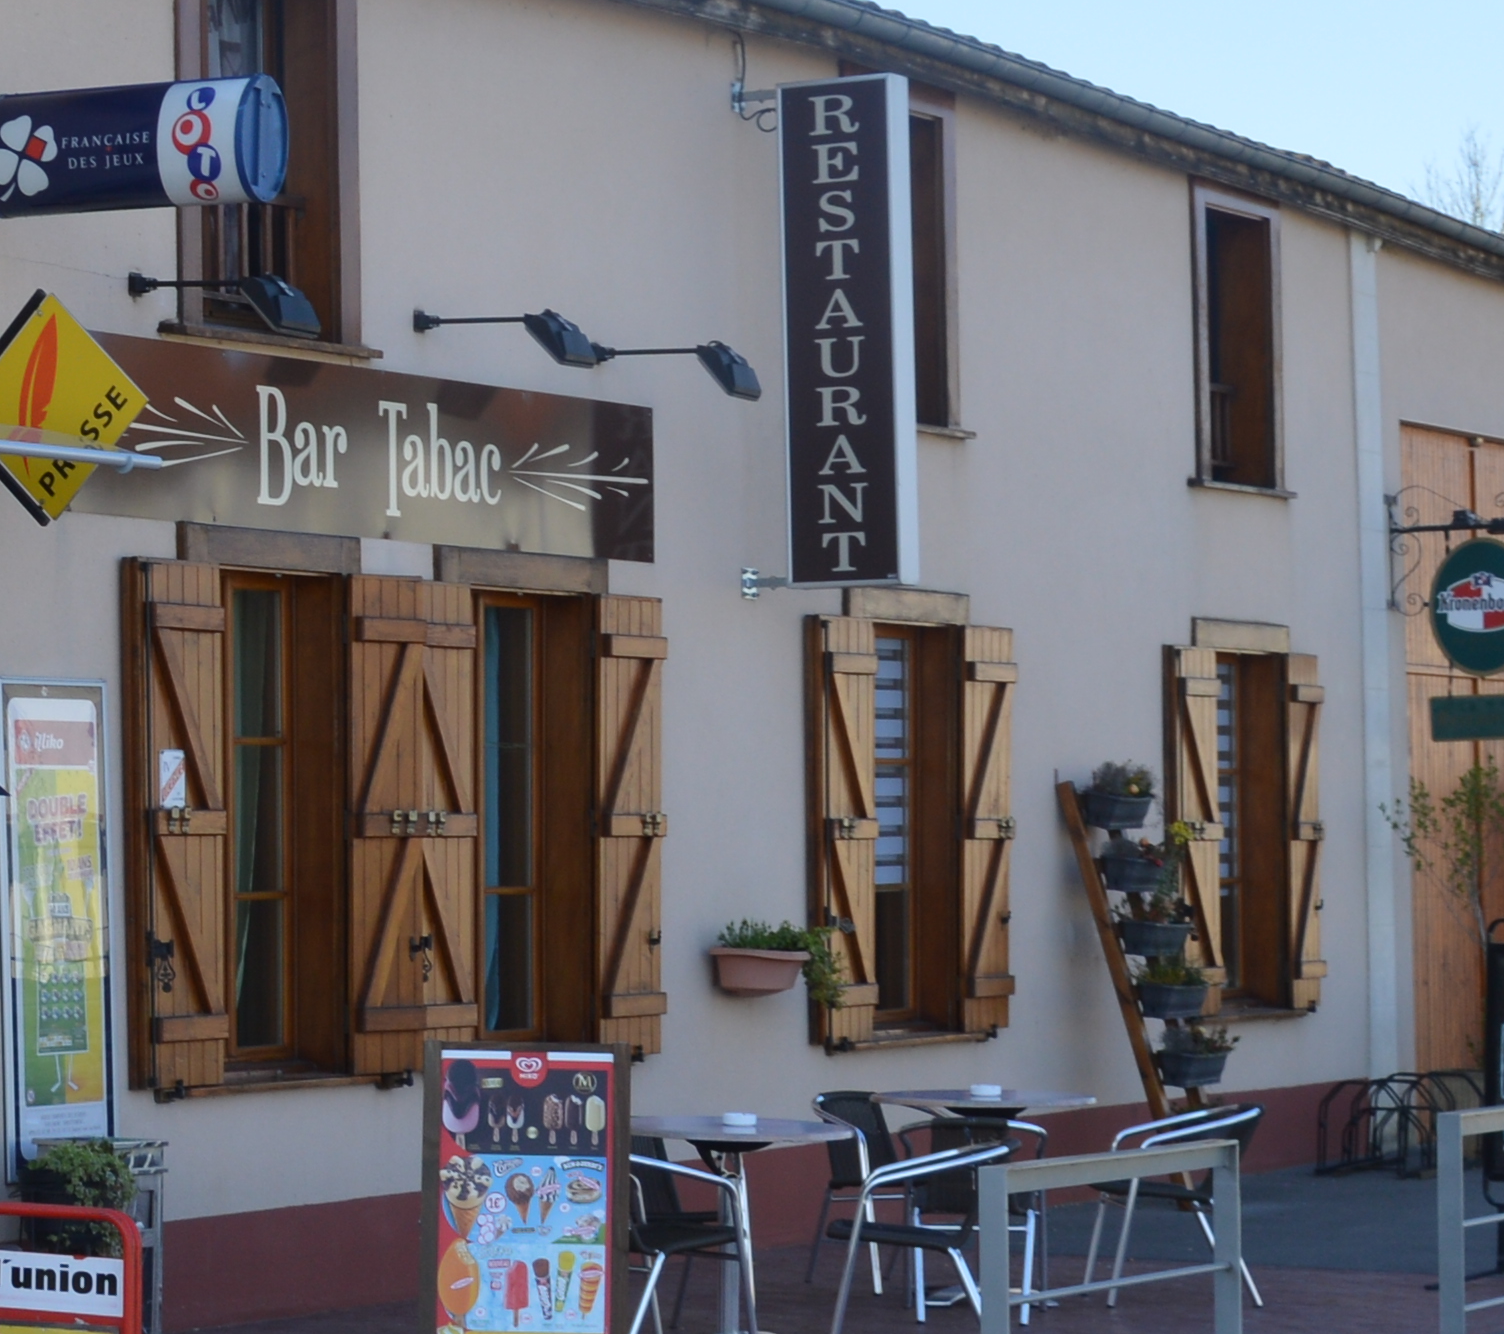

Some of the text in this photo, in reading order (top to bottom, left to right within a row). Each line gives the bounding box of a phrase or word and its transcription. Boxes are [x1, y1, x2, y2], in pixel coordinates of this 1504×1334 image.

[61, 131, 150, 151] FRANÇAISE
[68, 152, 144, 170] DES JEUX
[172, 87, 221, 201] LOTO
[807, 93, 869, 573] RESTAURANT
[38, 385, 129, 497] PRSSE
[256, 384, 502, 517] Bar Tabac
[27, 794, 87, 818] DOUBLE
